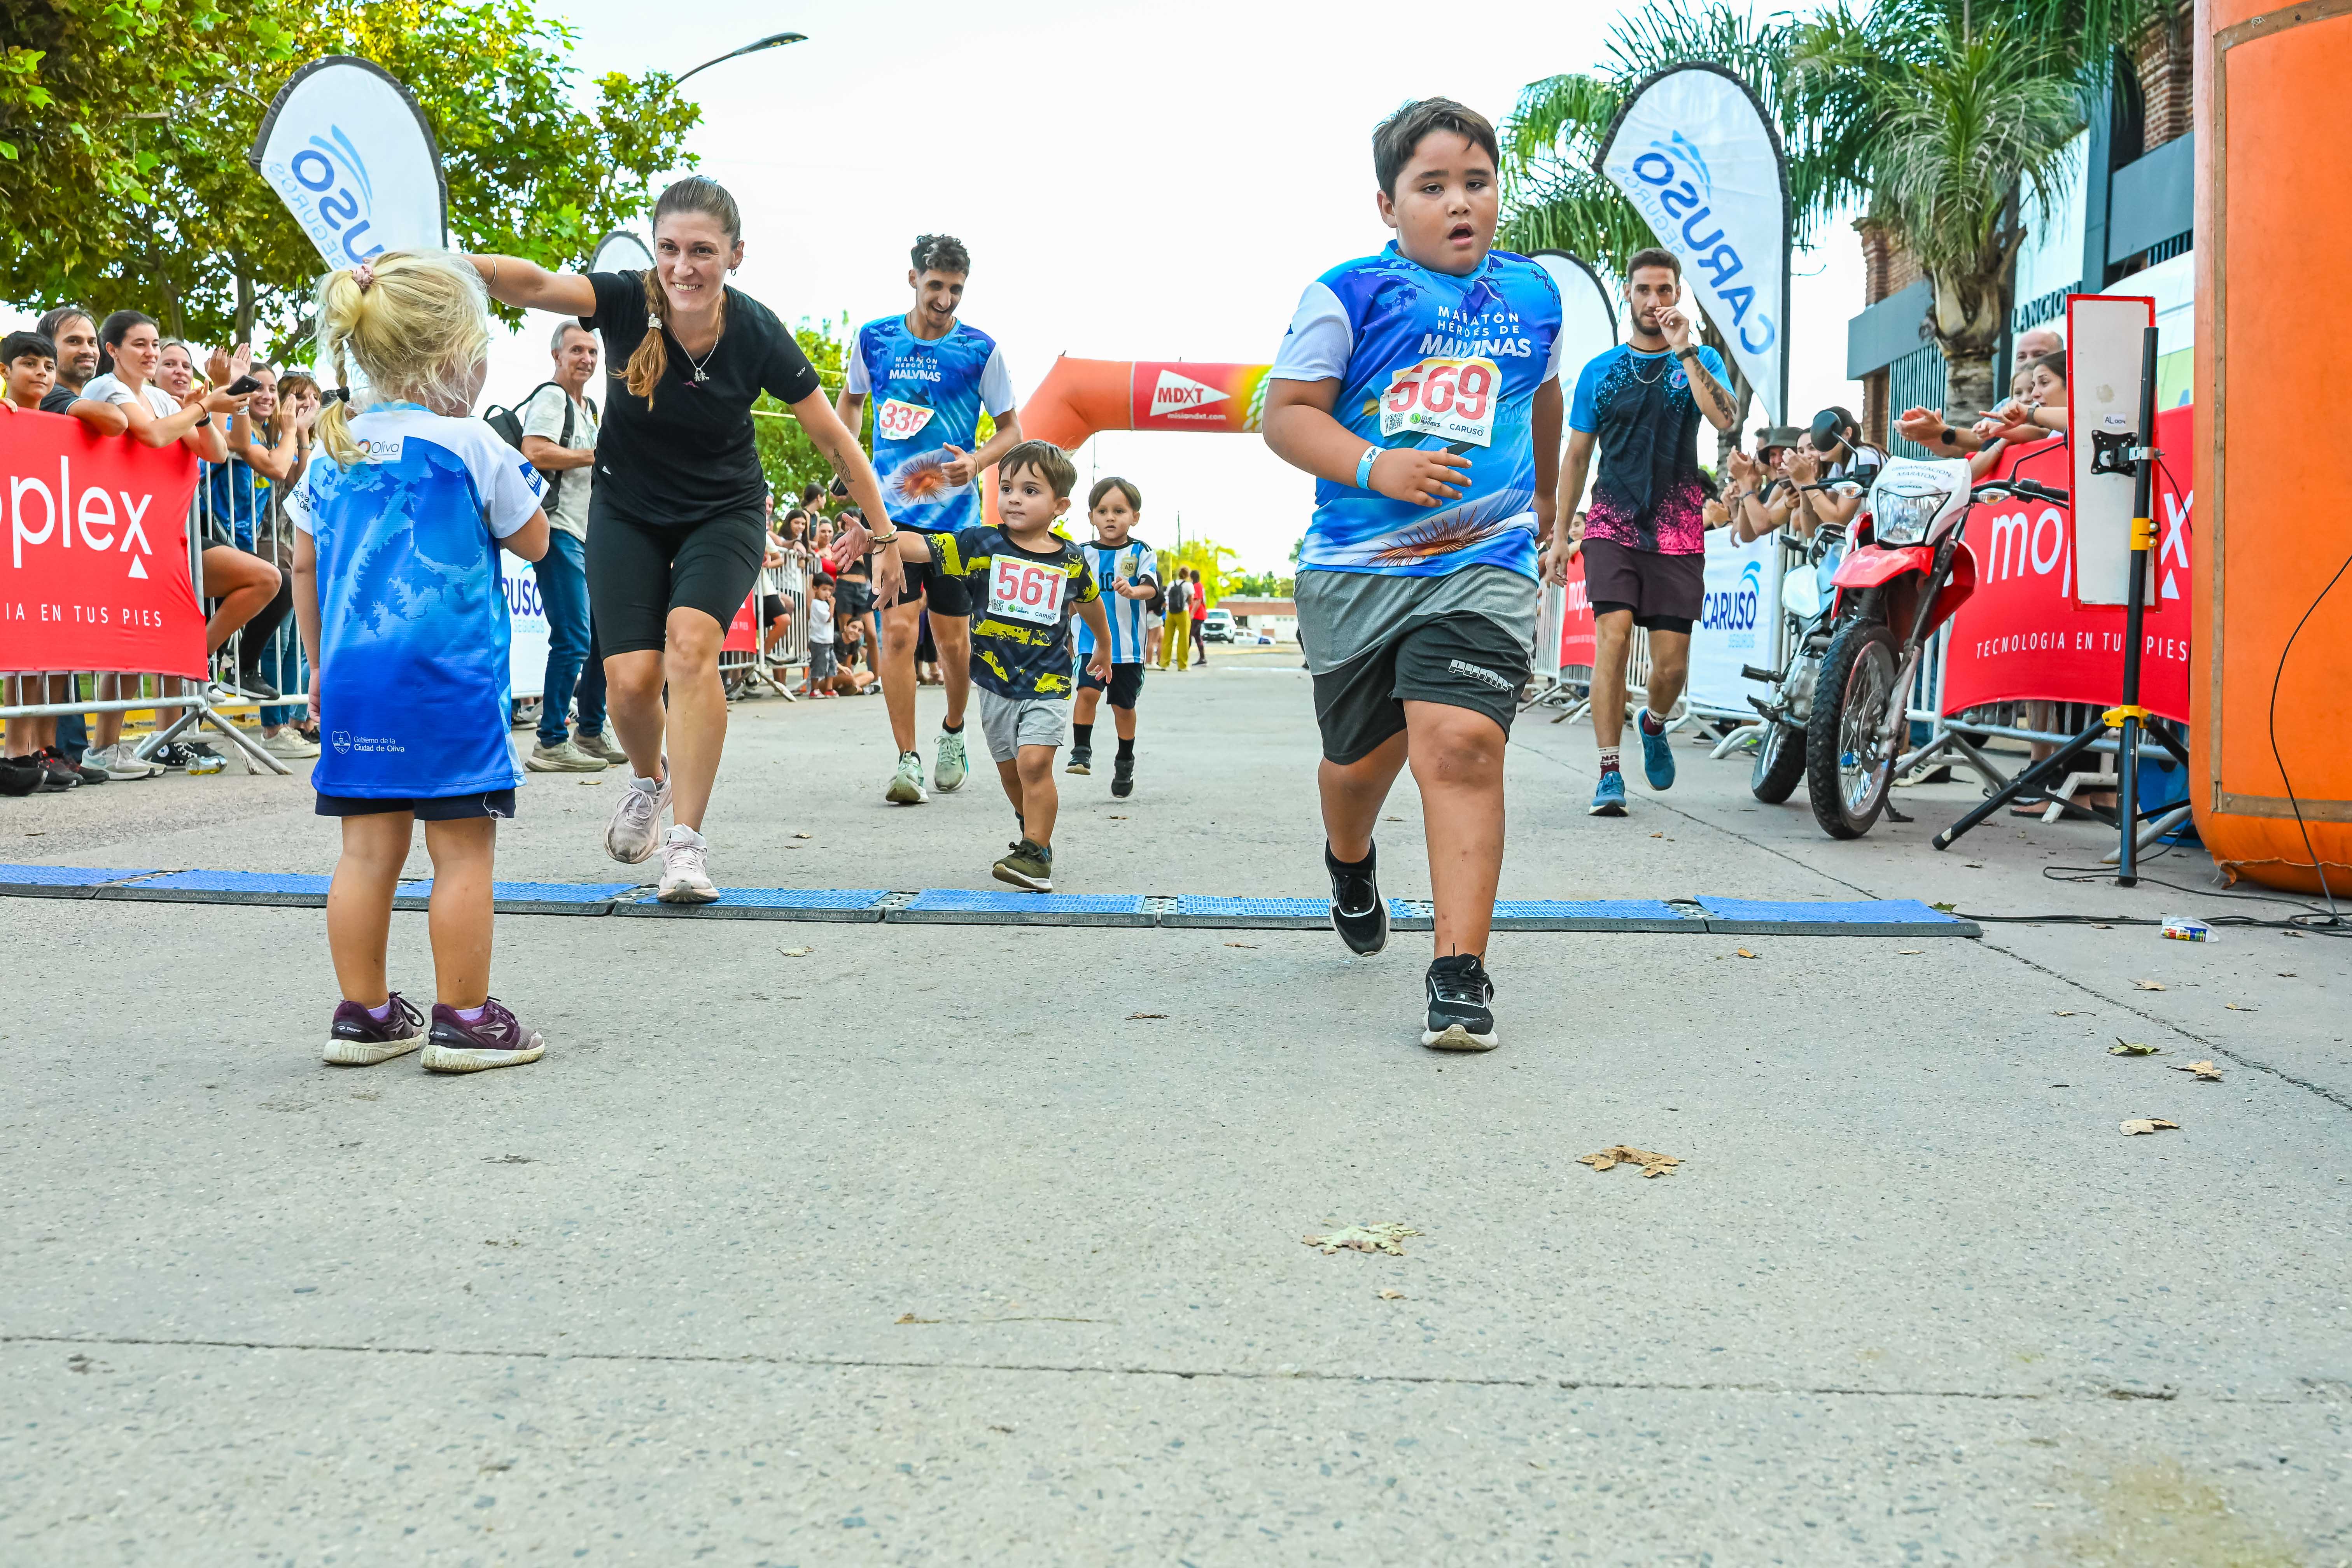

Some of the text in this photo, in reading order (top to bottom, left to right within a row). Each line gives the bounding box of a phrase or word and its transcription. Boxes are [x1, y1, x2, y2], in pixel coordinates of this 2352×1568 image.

[1500, 326, 1519, 334] DE
[889, 369, 941, 382] MALVINAS
[1158, 383, 1204, 405] MDXT
[1389, 365, 1491, 420] 569
[881, 403, 927, 432] 336
[1449, 424, 1483, 436] CARUSO
[371, 441, 399, 453] Oliva
[0, 455, 152, 569] plex
[996, 562, 1060, 610] 561
[1099, 572, 1115, 592] 10
[41, 604, 61, 621] EN
[74, 605, 108, 624] TUS
[123, 608, 162, 627] PIES
[1035, 612, 1055, 621] CARUSO
[1703, 591, 1756, 630] CARUSO
[1976, 632, 2188, 662] TECNOLOGIA EN TU PIES
